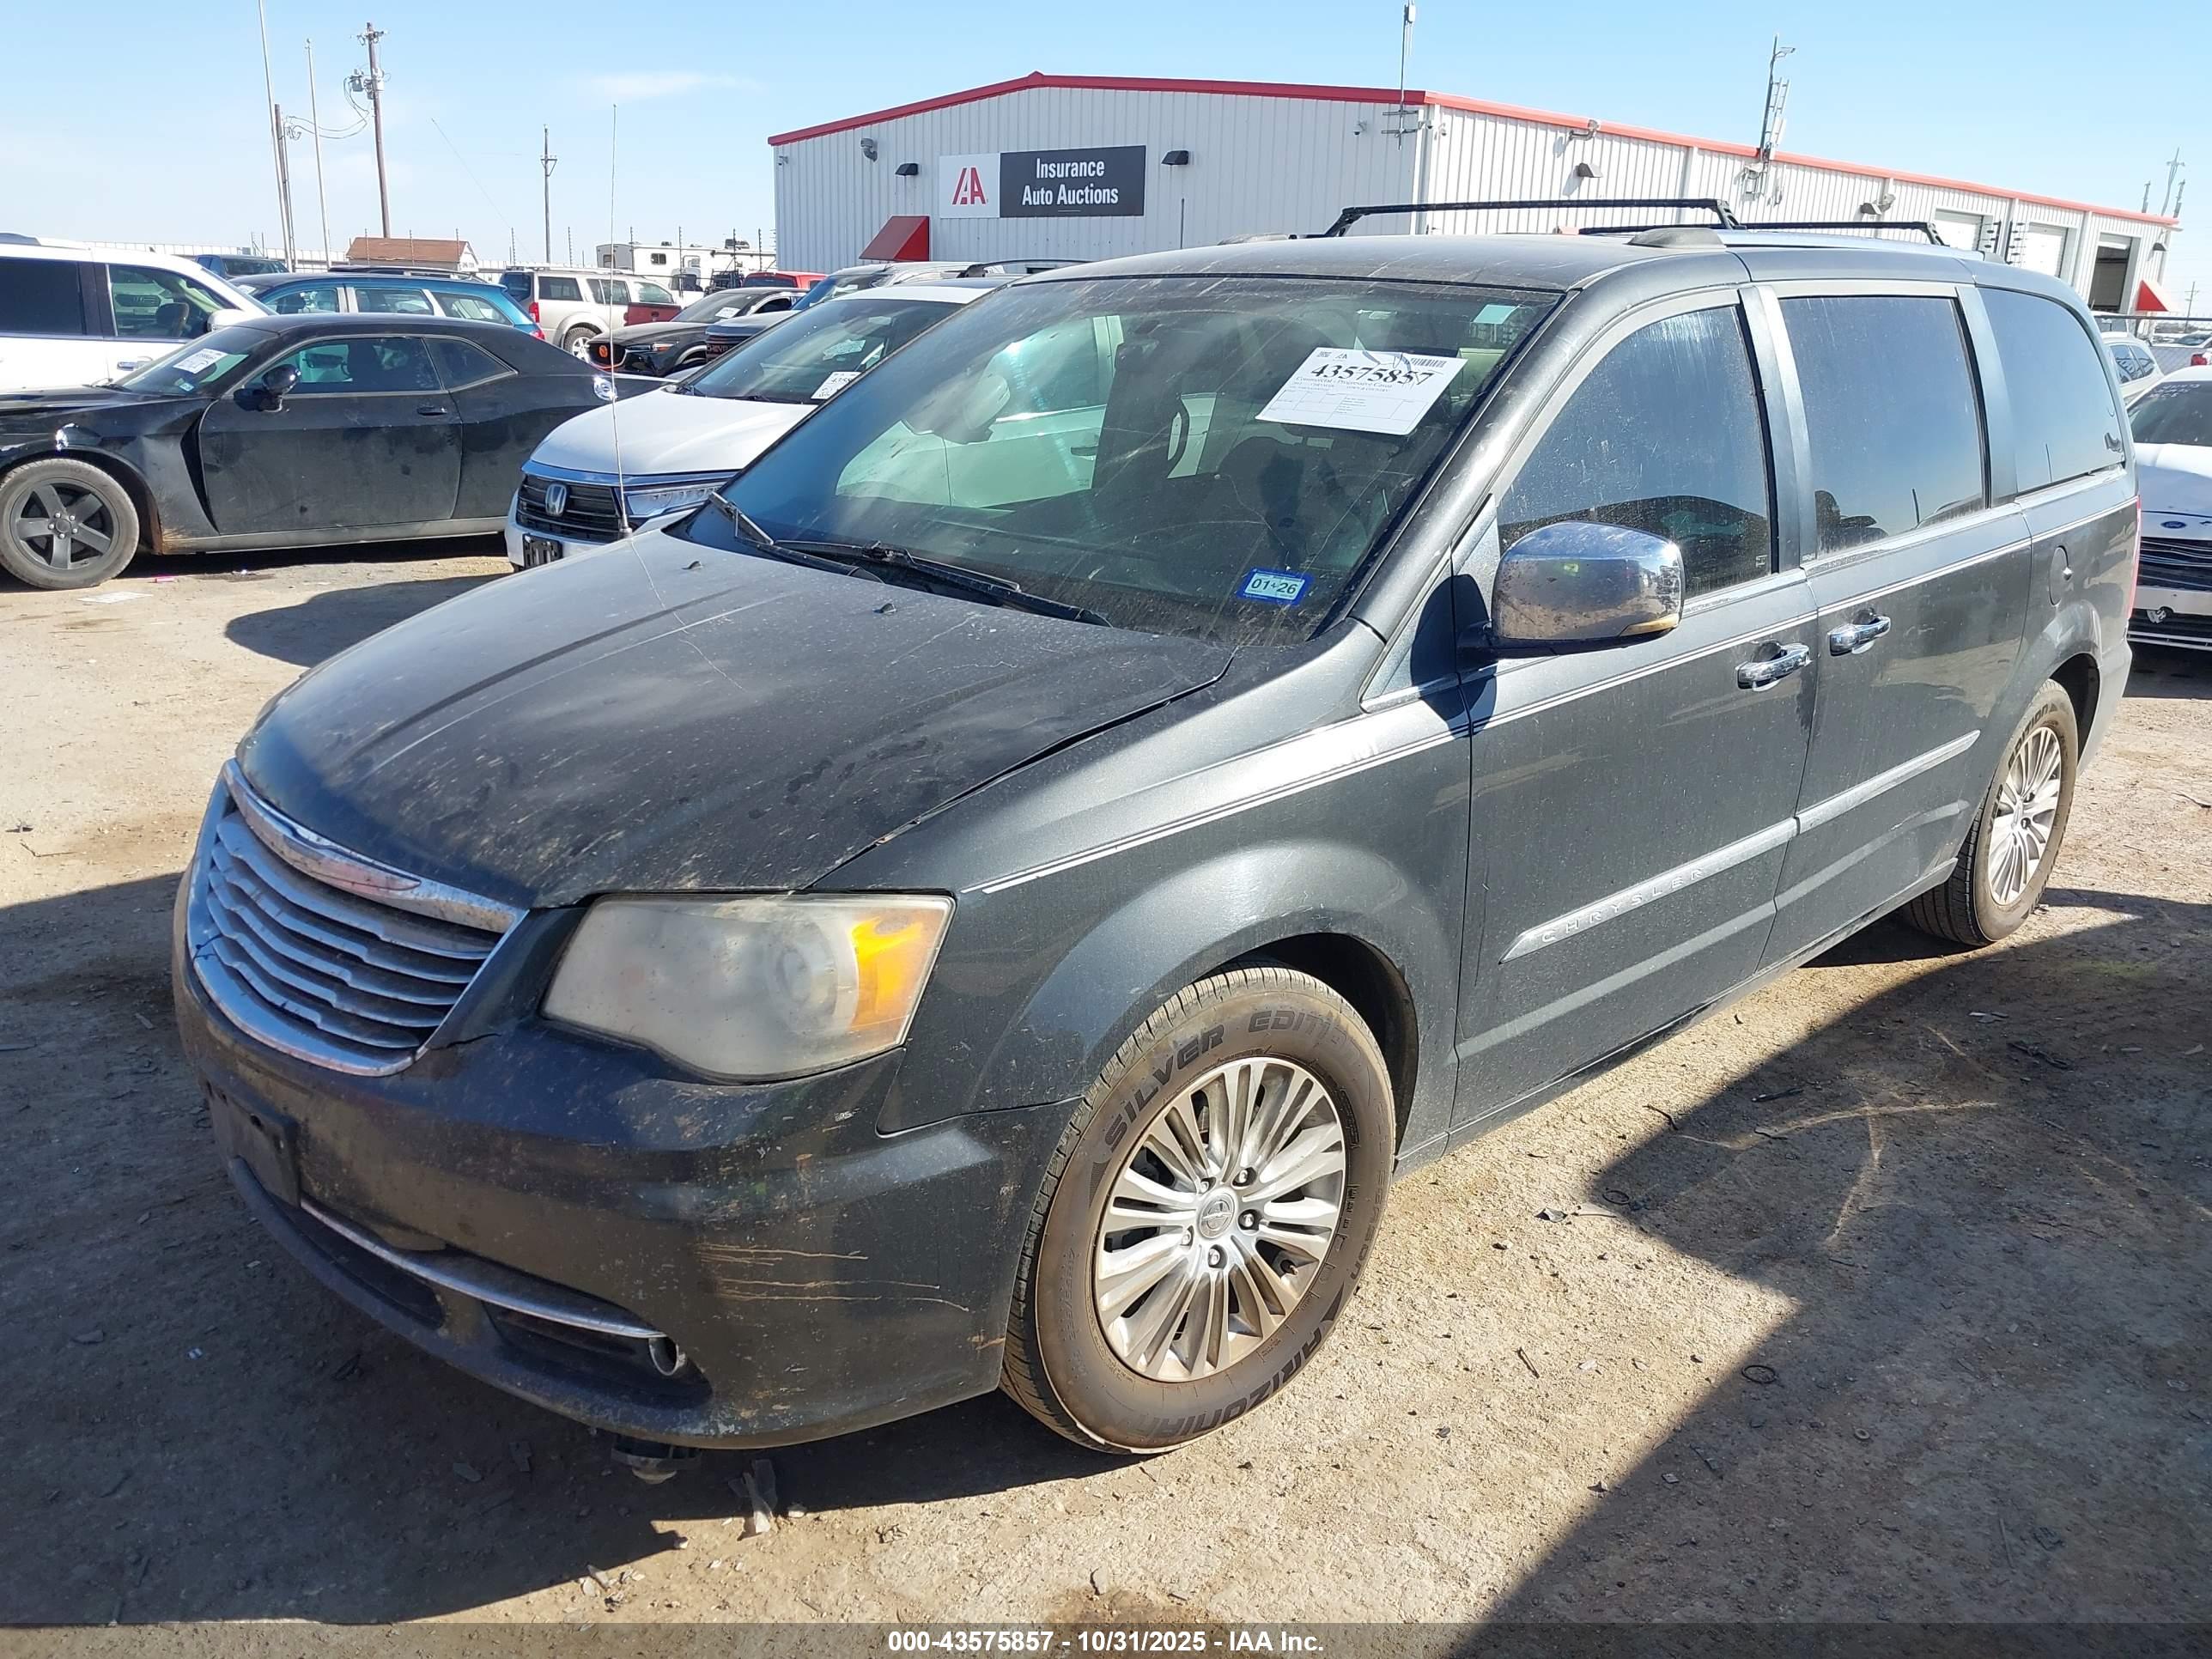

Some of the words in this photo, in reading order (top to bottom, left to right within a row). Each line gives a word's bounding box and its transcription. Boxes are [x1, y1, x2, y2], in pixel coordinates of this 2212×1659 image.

[1036, 157, 1105, 179] Insurance
[1022, 185, 1054, 205] Auto
[1056, 183, 1119, 204] Auctions
[1310, 363, 1434, 386] 43575857
[1541, 868, 1705, 943] CHRYSLER
[1104, 1024, 1224, 1153] SILVER
[1127, 1328, 1323, 1437] ARIZONIAN
